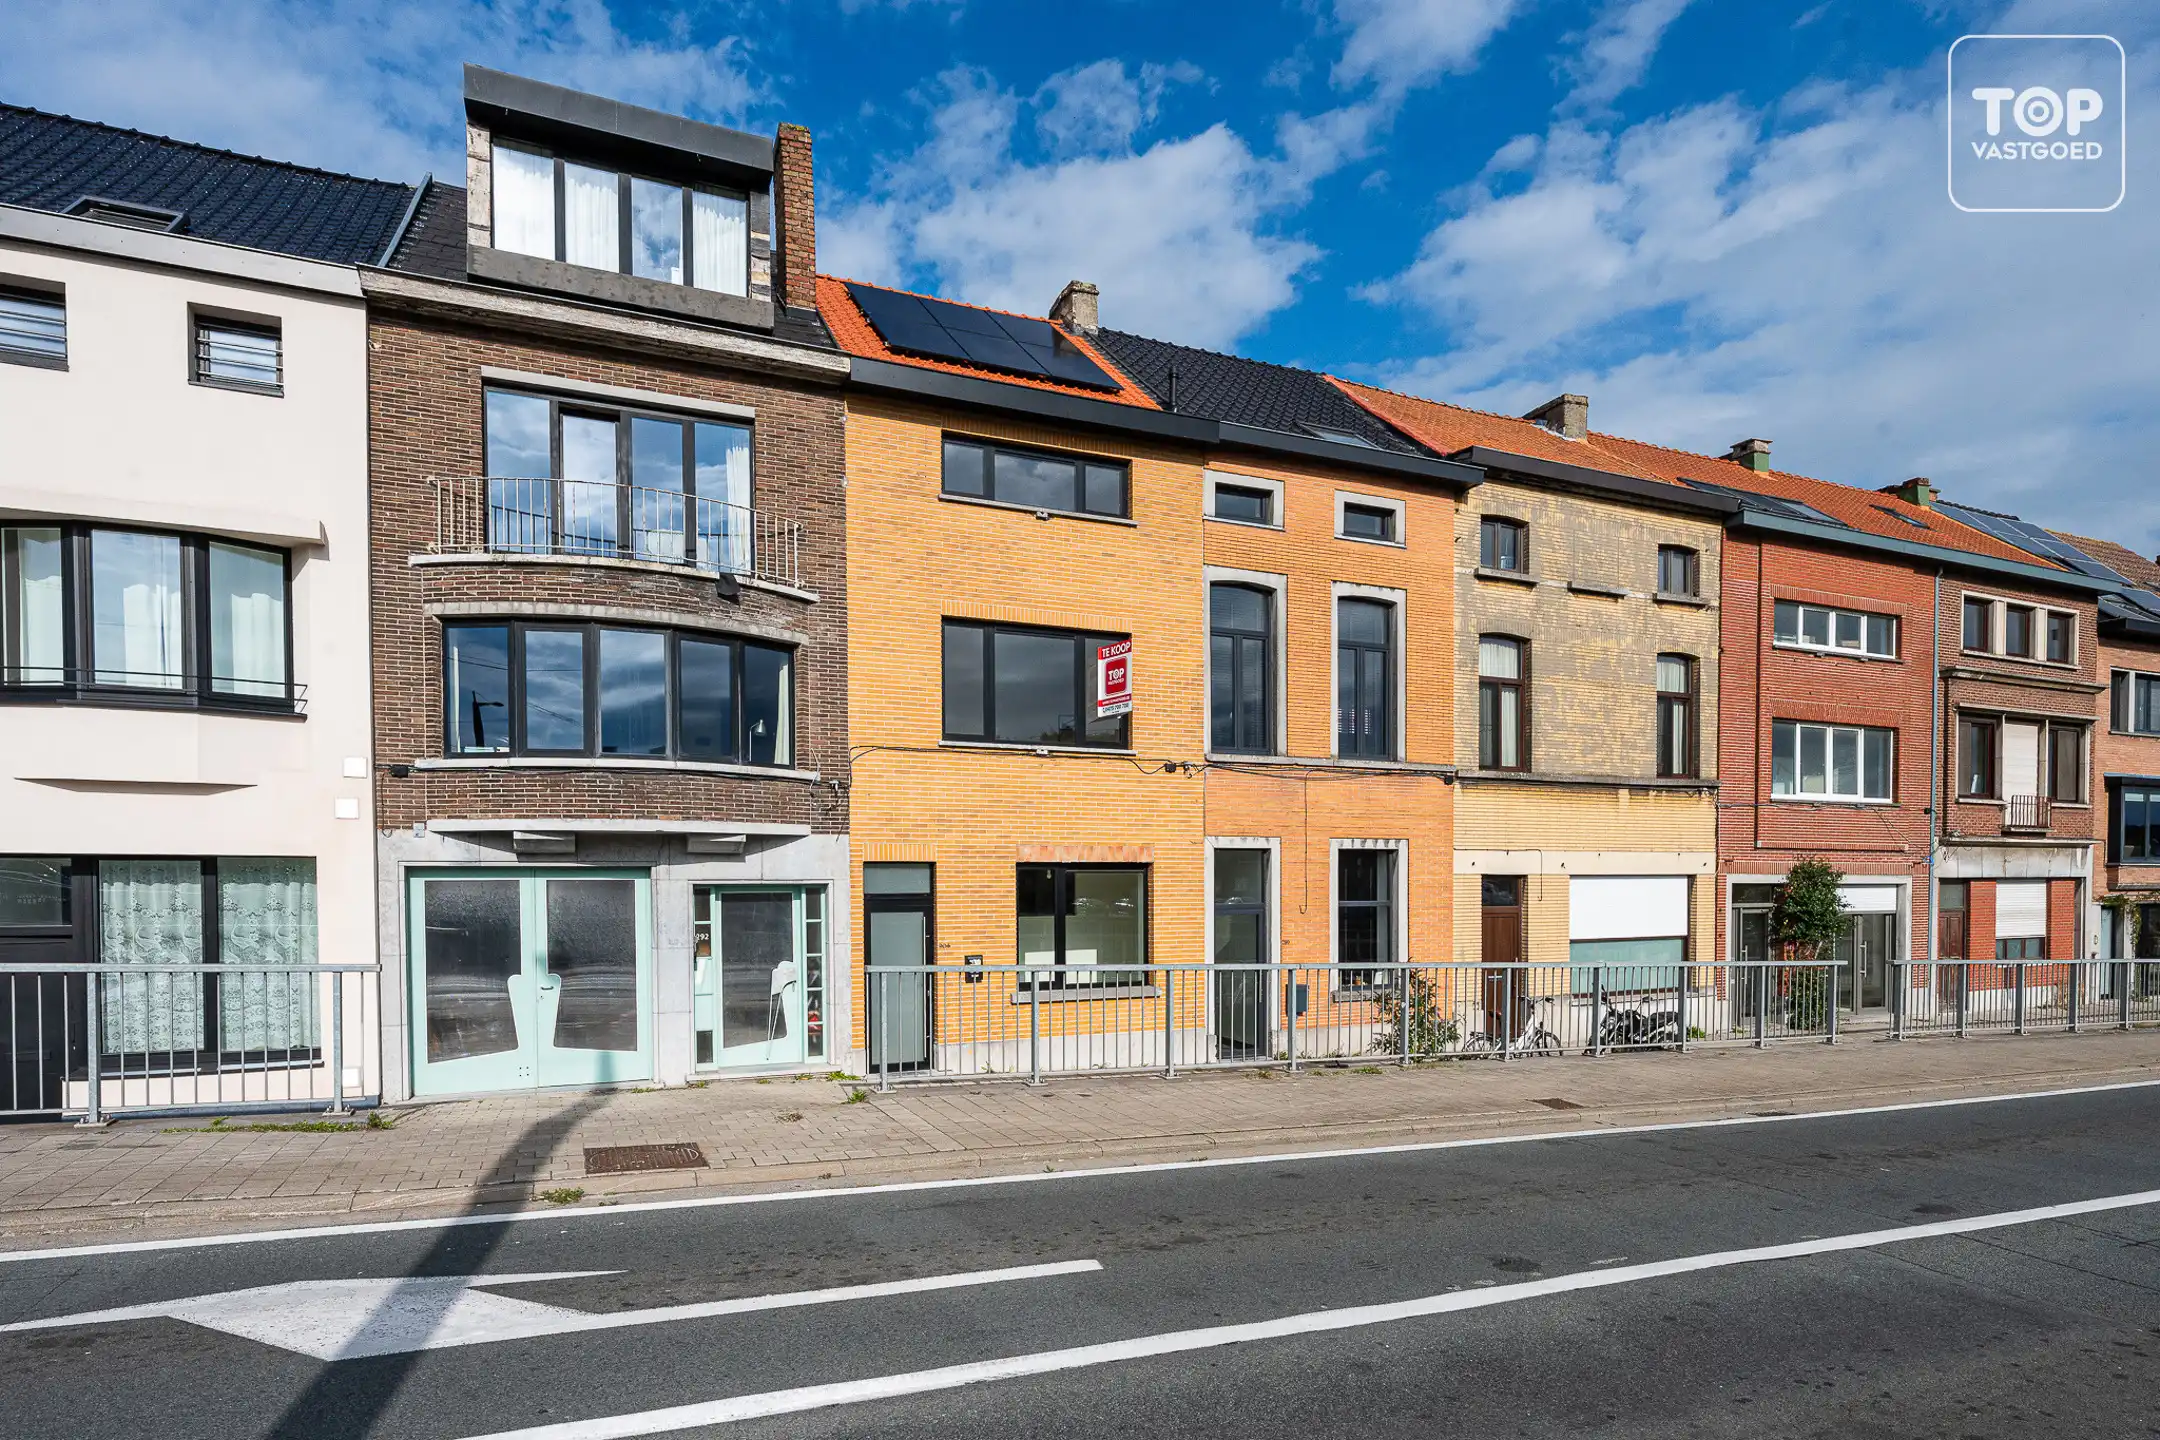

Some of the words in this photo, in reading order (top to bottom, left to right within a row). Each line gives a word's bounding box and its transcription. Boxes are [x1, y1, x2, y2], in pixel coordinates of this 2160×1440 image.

[1102, 648, 1110, 658] TE
[1111, 641, 1131, 656] KOOP
[1108, 668, 1125, 681] TOP
